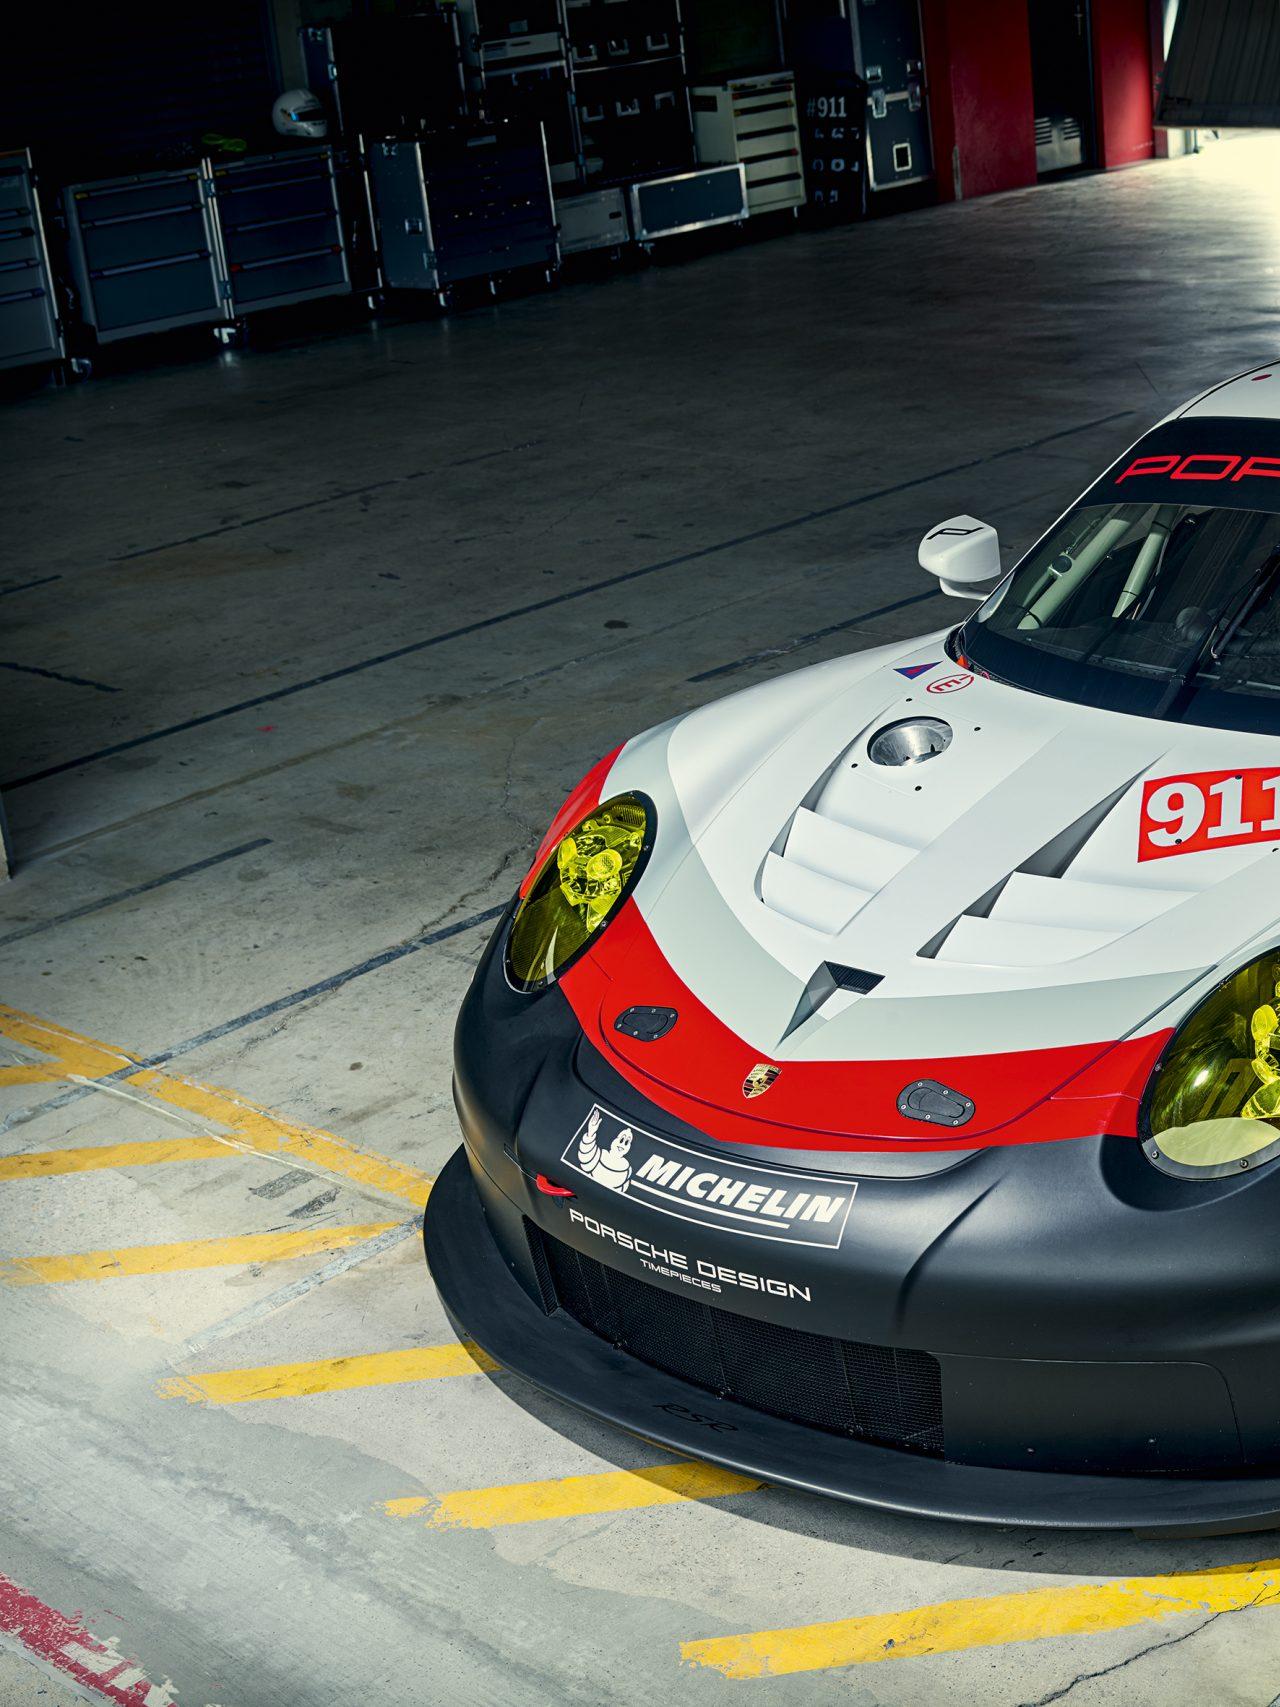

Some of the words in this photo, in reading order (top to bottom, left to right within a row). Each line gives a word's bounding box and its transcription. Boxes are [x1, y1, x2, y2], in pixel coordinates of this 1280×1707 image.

[806, 96, 847, 118] #911
[636, 1154, 846, 1223] MICHELIN
[569, 1208, 689, 1270] PORSCHE
[697, 1260, 811, 1302] DESIGN
[640, 1258, 722, 1293] TIMEPIECES
